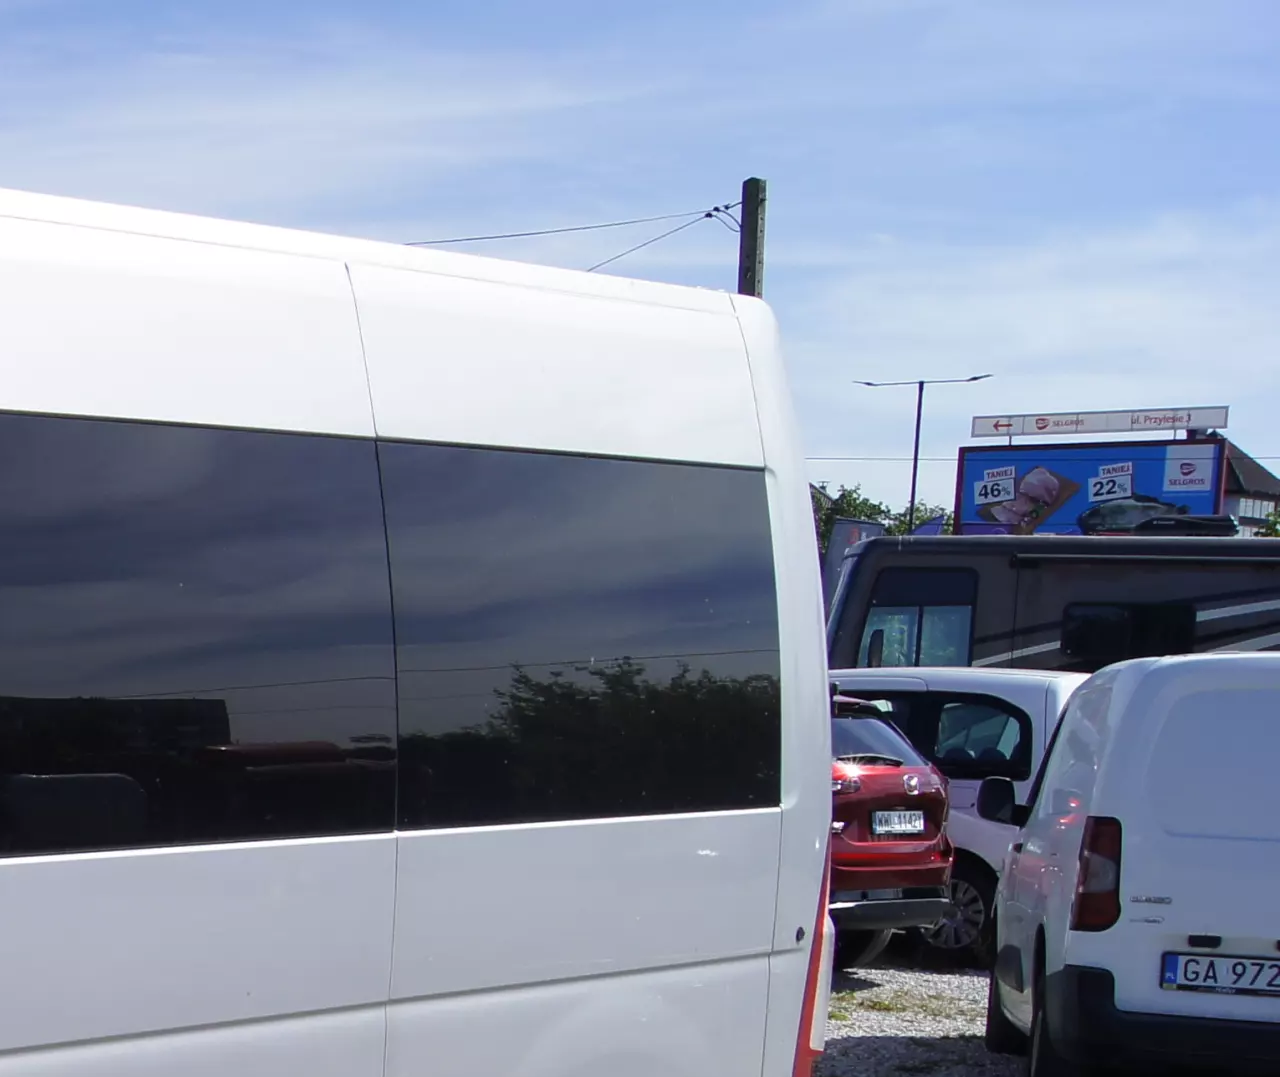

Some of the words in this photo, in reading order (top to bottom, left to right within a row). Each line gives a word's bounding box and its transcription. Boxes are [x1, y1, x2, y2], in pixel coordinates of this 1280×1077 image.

[986, 467, 1013, 479] TANIEJ
[1101, 463, 1130, 476] TANIEJ
[1168, 478, 1205, 486] SELGROS
[1183, 958, 1218, 985] GA
[1231, 961, 1280, 988] 972
